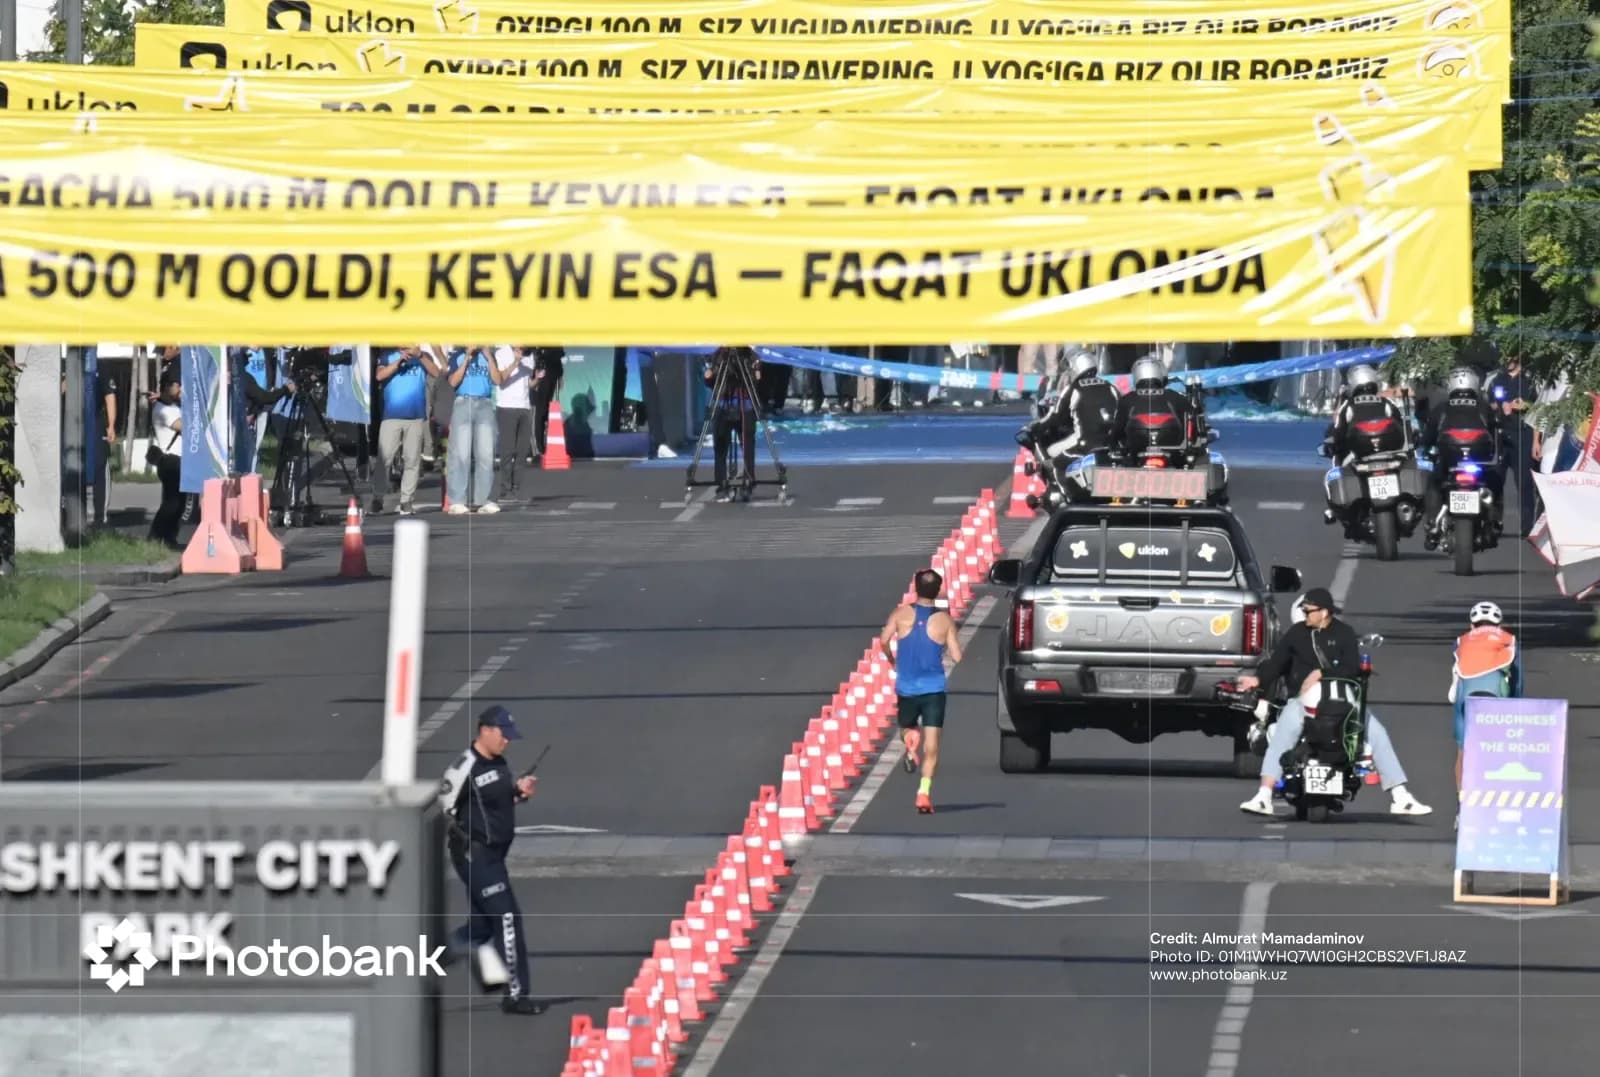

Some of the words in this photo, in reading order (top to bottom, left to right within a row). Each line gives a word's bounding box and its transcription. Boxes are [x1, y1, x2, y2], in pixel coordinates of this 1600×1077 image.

[326, 10, 415, 33] uklon
[601, 17, 650, 33] 100
[660, 18, 682, 33] M
[536, 60, 588, 78] 100
[599, 60, 621, 78] M
[642, 60, 687, 80] SIZ
[1116, 61, 1162, 80] BIZ
[1250, 57, 1389, 80] BORAMIZ
[288, 177, 328, 209] M
[28, 252, 136, 299] 500
[157, 253, 200, 299] M
[220, 253, 406, 310] QOLDI,
[427, 253, 592, 299] KEYIN
[613, 254, 718, 299] ESA
[803, 252, 980, 301] FAQAT
[1002, 249, 1267, 299] UKLONDA
[1138, 544, 1169, 556] uklon
[1076, 615, 1203, 642] JAC
[1506, 728, 1524, 738] OF
[1480, 741, 1504, 753] THE
[257, 841, 398, 889] CITY
